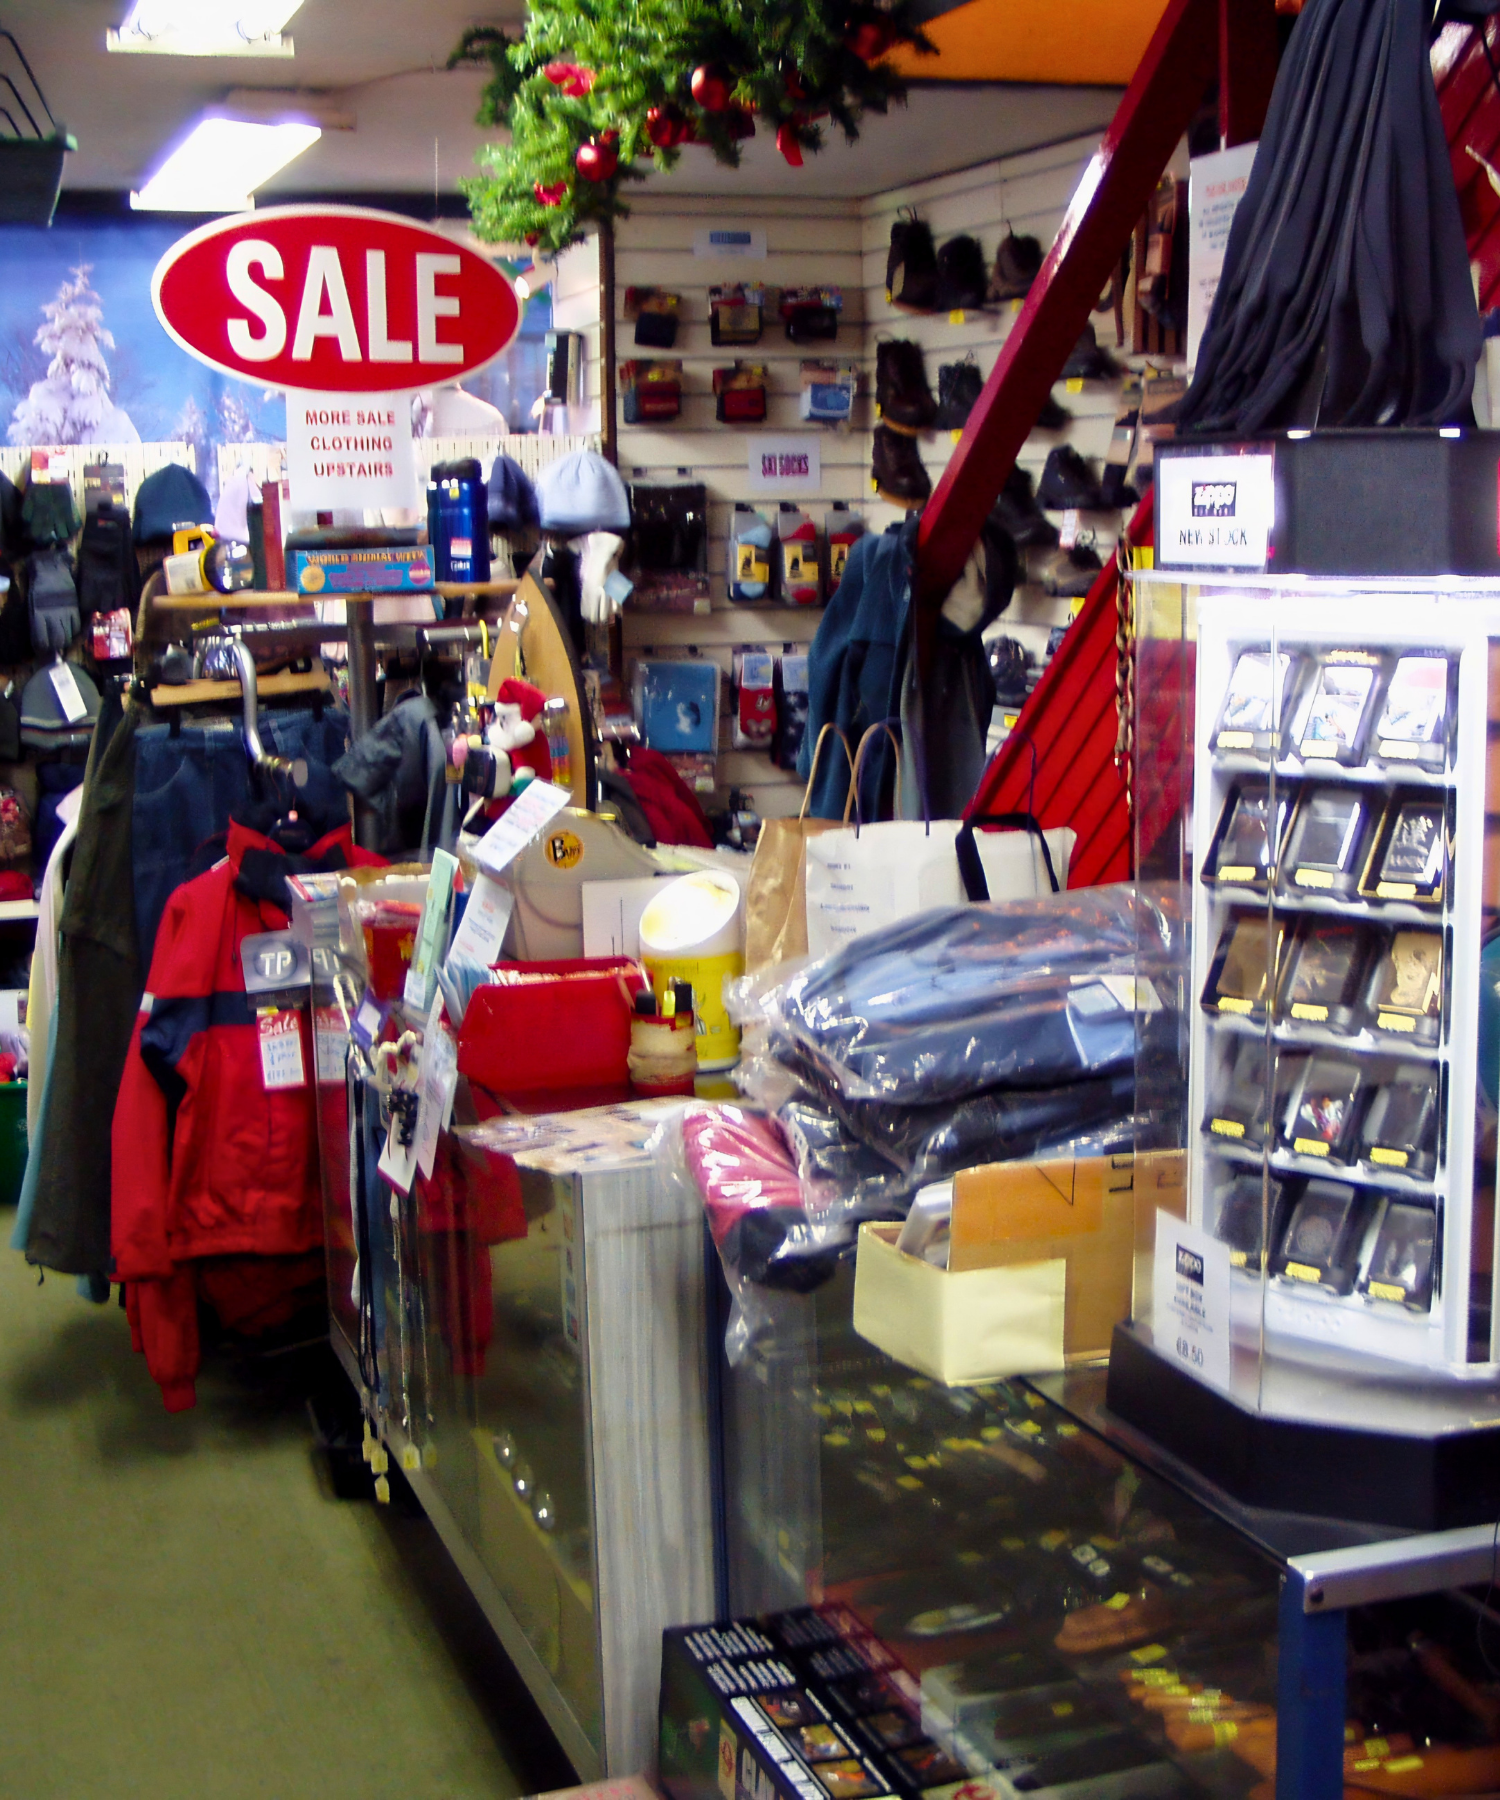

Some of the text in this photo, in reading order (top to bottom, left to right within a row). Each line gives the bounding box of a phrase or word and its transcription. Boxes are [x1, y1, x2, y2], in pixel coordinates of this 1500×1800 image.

[226, 239, 464, 364] SALE
[305, 409, 396, 426] MORE SALE
[310, 435, 393, 452] CLOTHING
[313, 461, 394, 478] UPSTAIRS
[1179, 529, 1203, 546] NEW
